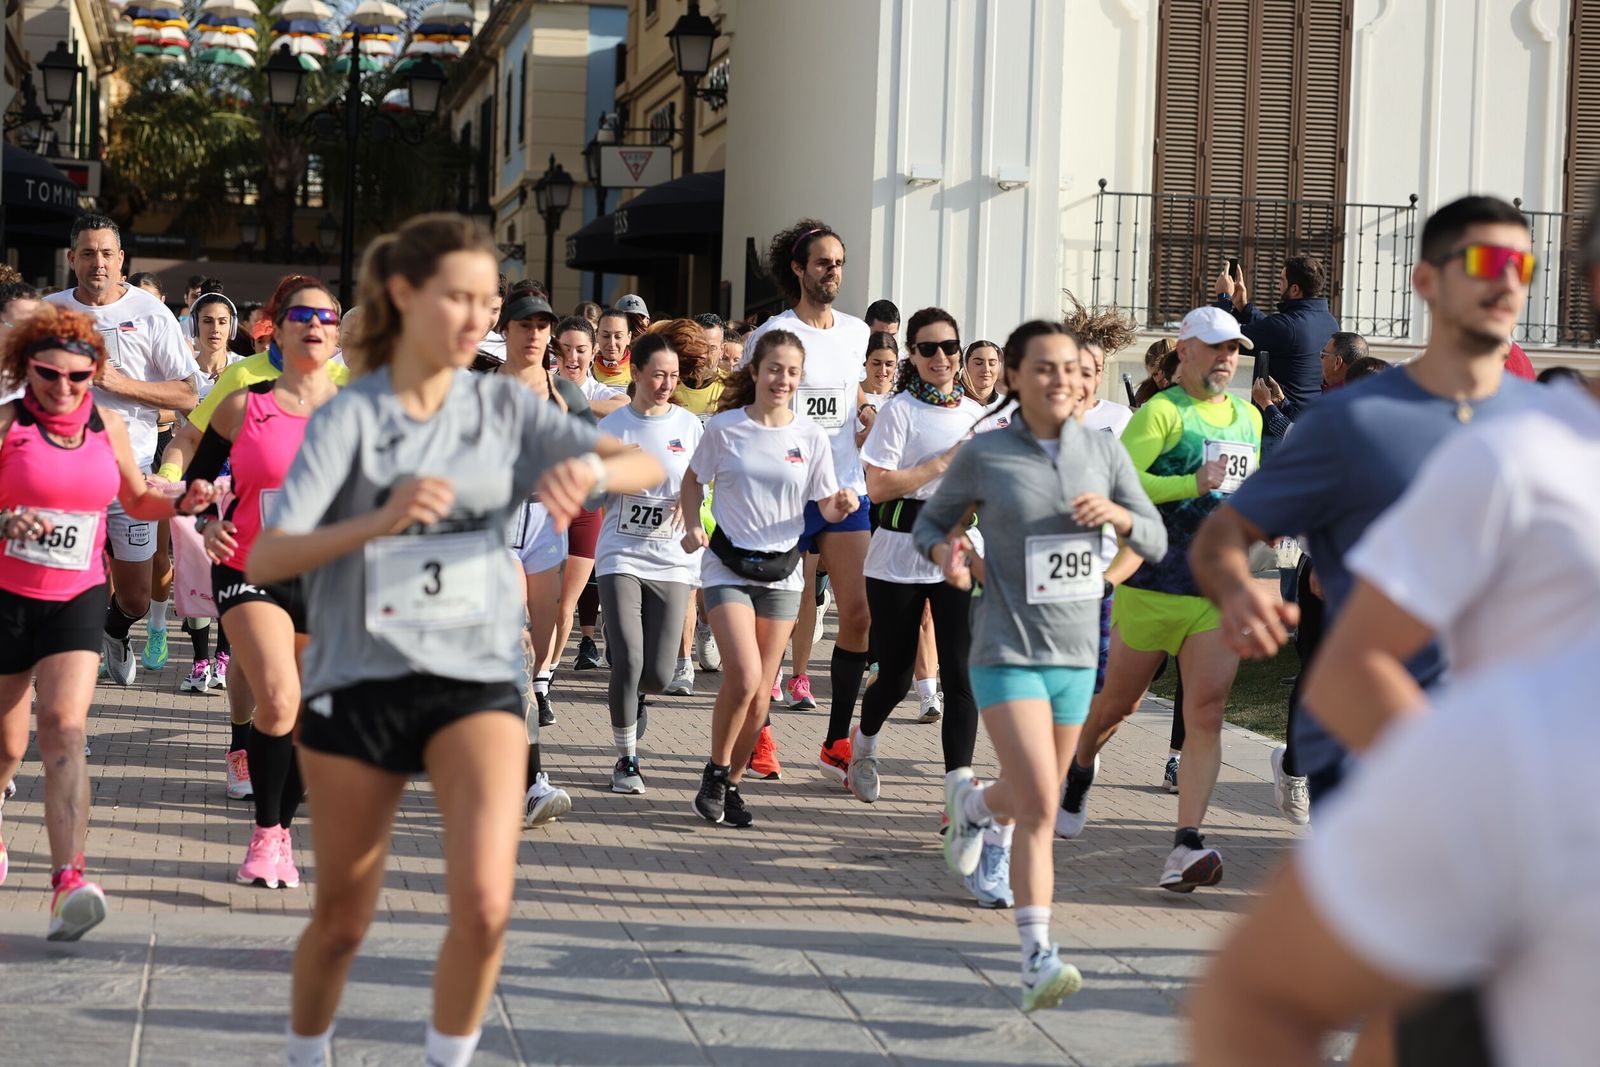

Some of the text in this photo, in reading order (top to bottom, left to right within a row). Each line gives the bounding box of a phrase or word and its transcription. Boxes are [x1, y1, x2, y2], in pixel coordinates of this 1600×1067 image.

[806, 397, 837, 416] 204
[629, 504, 663, 527] 275
[1049, 551, 1092, 580] 299
[423, 560, 442, 596] 3
[218, 583, 267, 604] NIK
